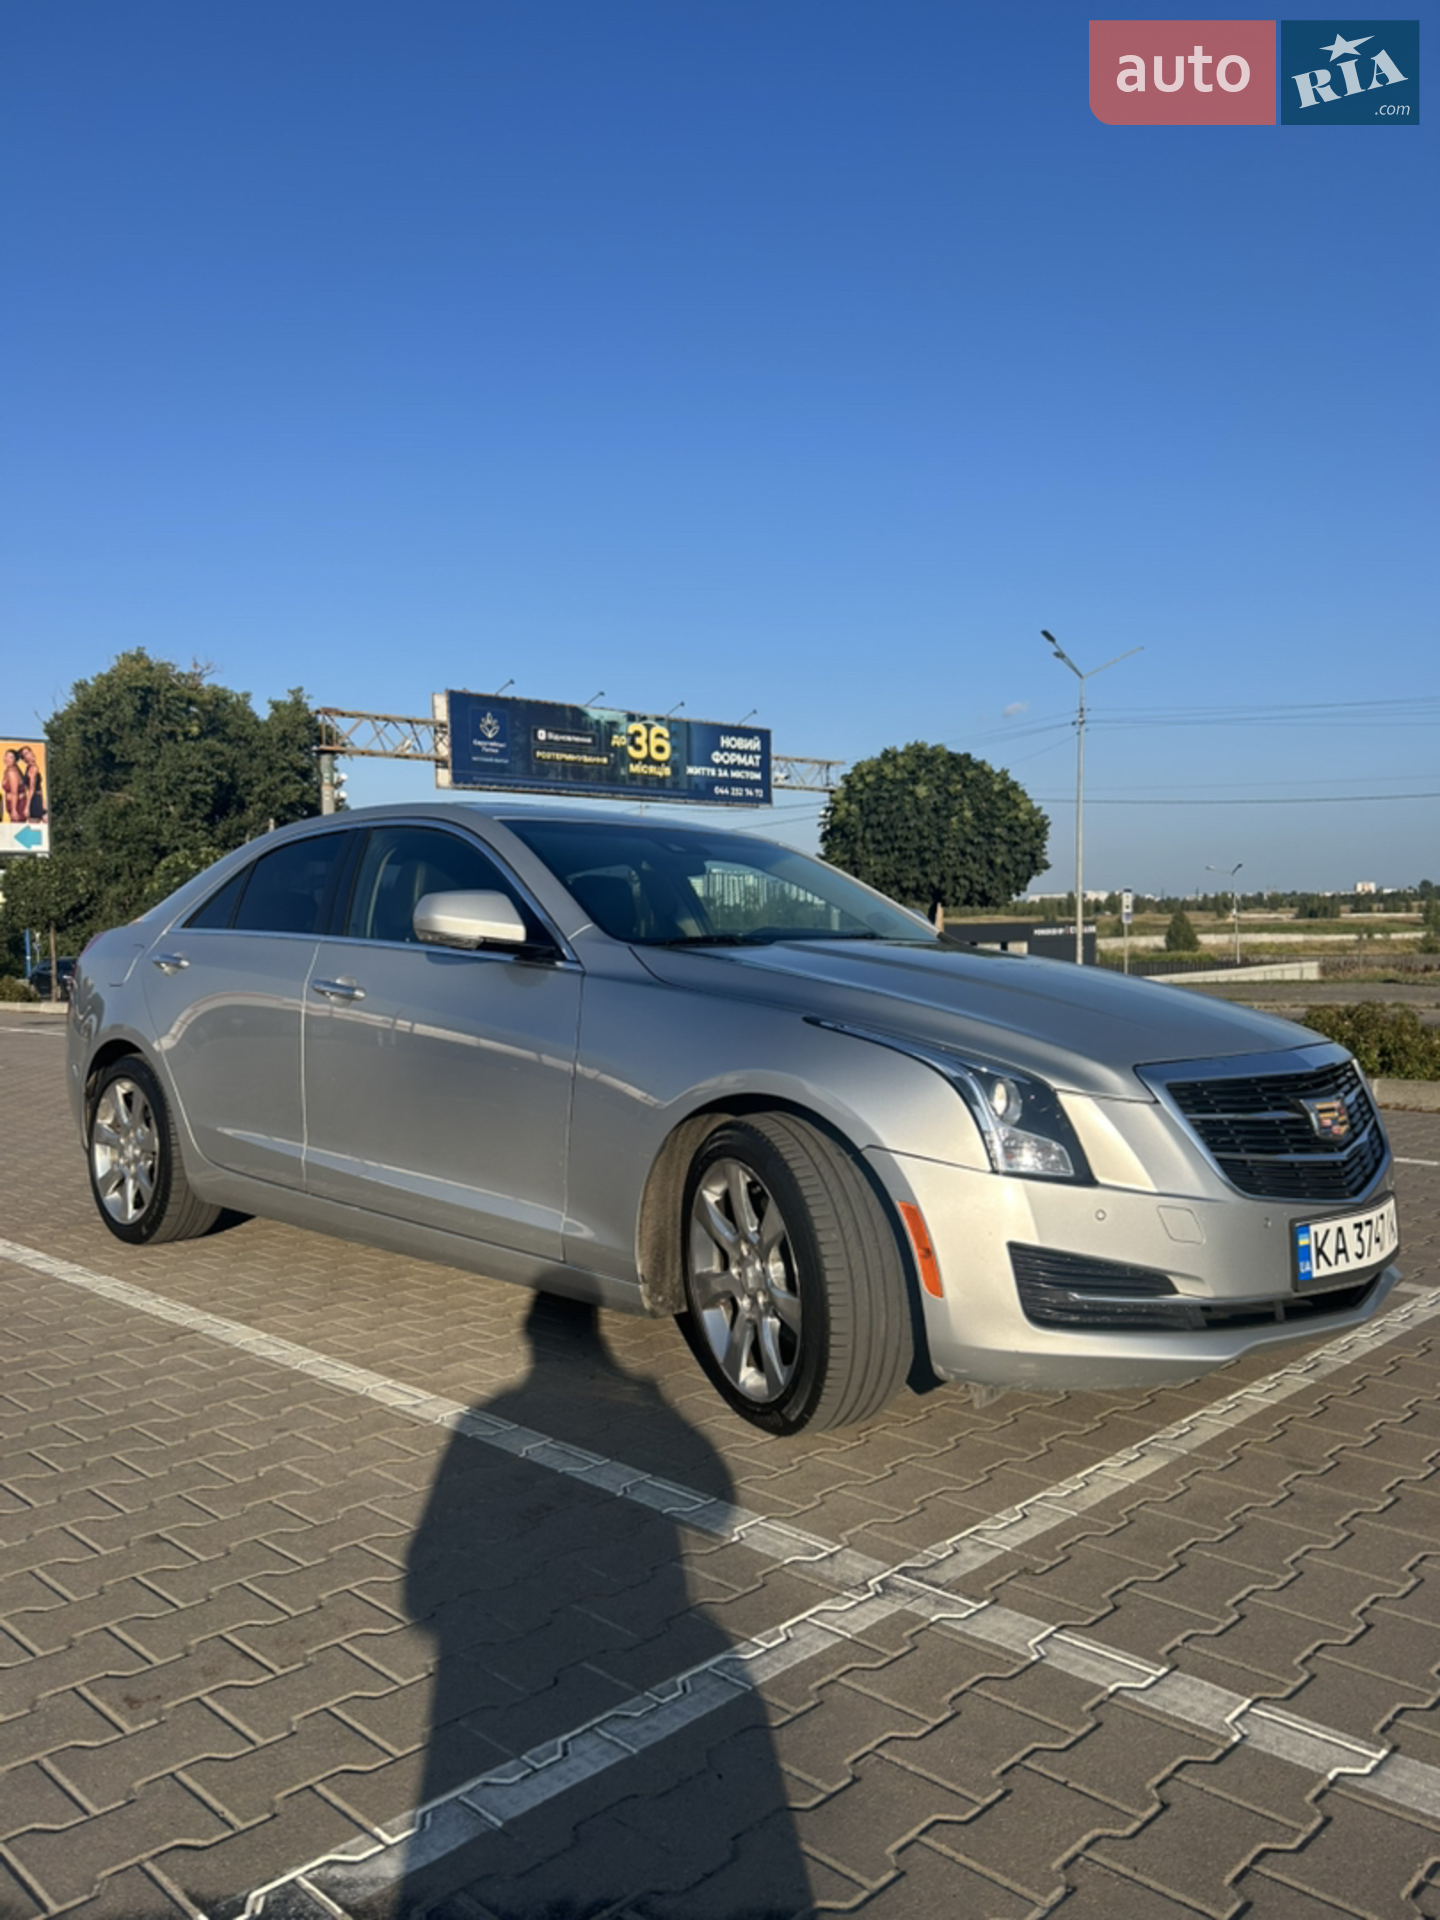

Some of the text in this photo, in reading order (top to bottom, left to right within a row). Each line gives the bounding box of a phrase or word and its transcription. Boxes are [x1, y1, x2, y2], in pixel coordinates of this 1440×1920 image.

[627, 723, 671, 761] 36
[720, 734, 761, 752] НОВИЙ
[711, 750, 761, 767] ФОРМАТ
[1313, 1226, 1350, 1270] KA
